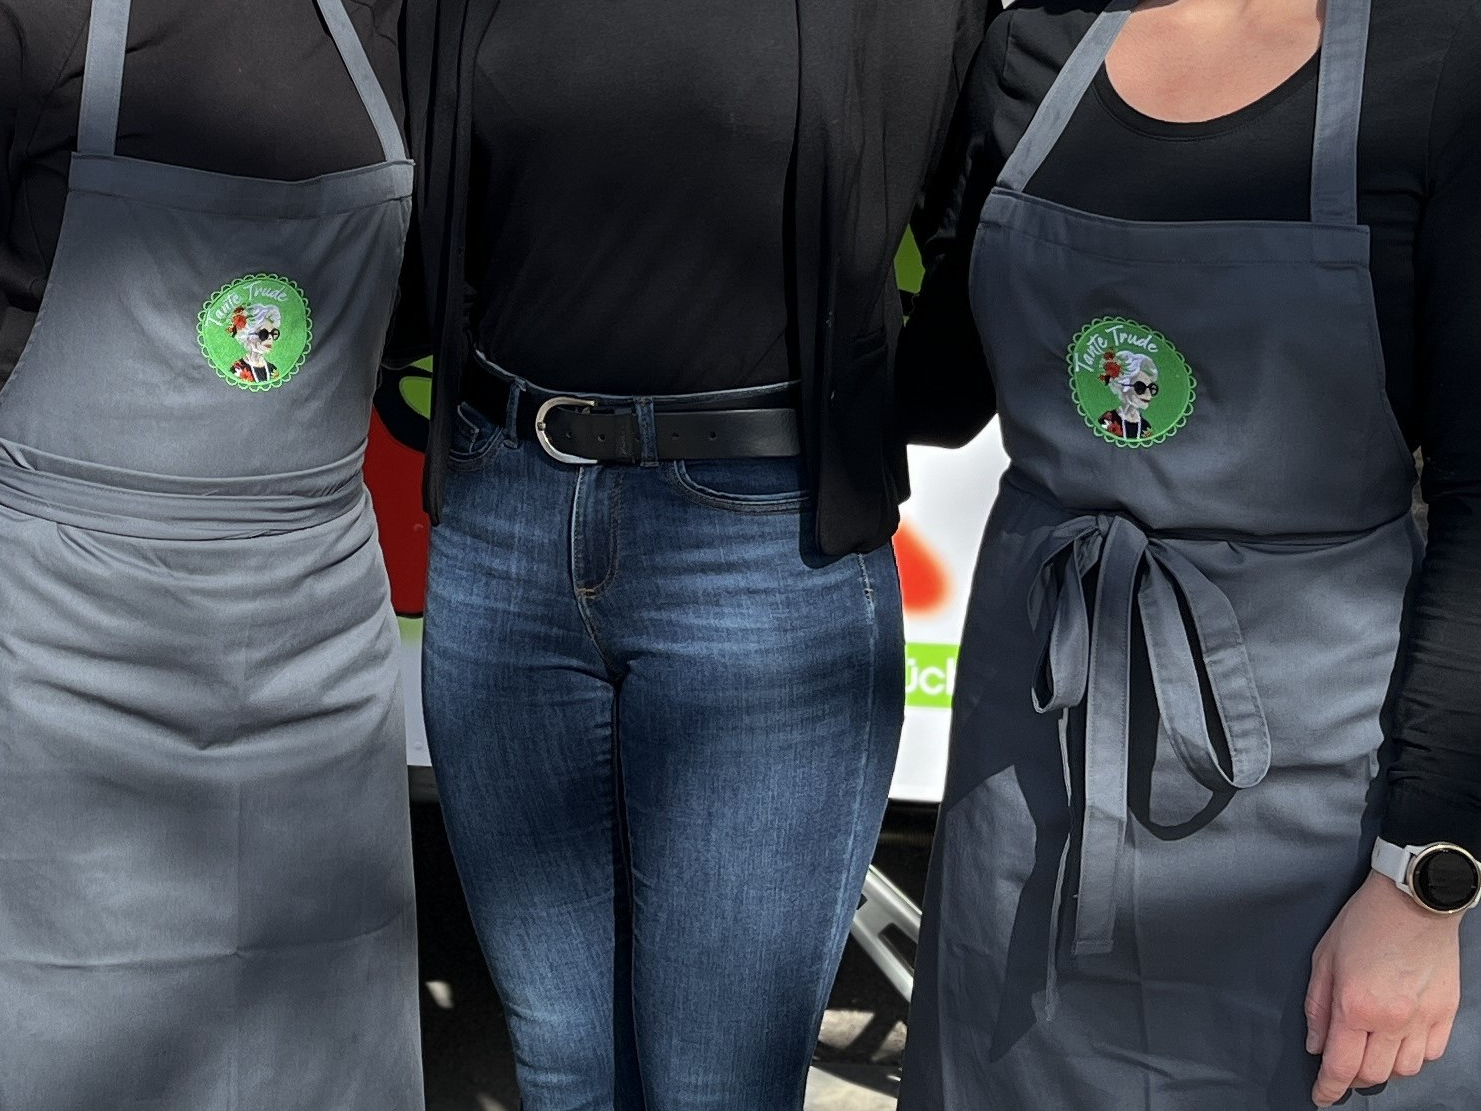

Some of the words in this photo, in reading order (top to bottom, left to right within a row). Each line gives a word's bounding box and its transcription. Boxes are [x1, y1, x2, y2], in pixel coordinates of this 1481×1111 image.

[204, 292, 242, 326] Tante
[243, 280, 289, 303] Trude
[1074, 334, 1108, 373] Tante
[1105, 325, 1159, 353] Trude
